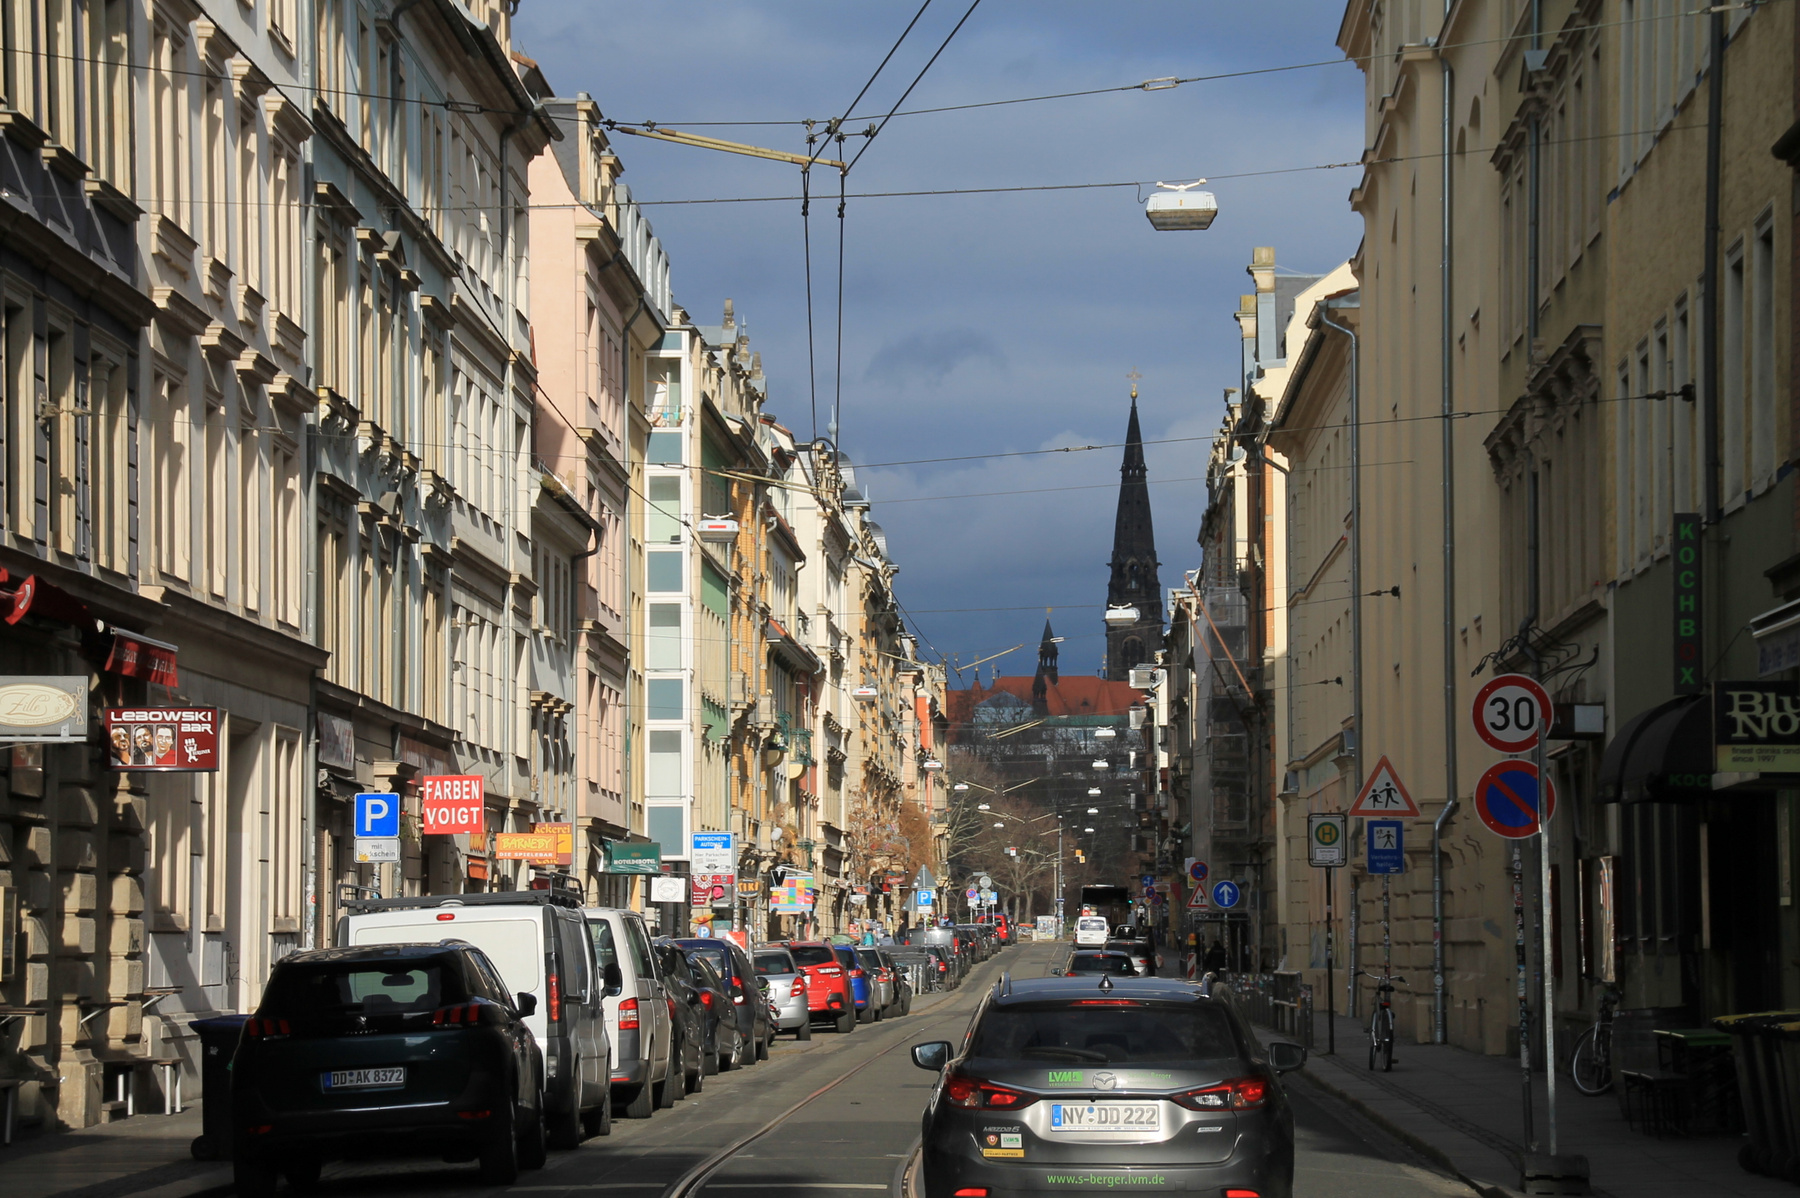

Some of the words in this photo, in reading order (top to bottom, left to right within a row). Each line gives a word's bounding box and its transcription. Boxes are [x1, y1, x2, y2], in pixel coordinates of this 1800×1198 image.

[1679, 522, 1696, 685] KOCHBOX
[111, 711, 212, 722] LEBOWSKI
[1489, 696, 1535, 731] 30
[181, 723, 214, 735] BAR
[1756, 747, 1781, 755] drinks
[1732, 755, 1755, 763] since
[1757, 755, 1776, 763] 1997
[425, 780, 480, 800] FARBEN
[365, 799, 389, 832] P
[426, 807, 481, 825] VOIGT
[1322, 827, 1332, 840] H
[371, 842, 383, 850] mit
[501, 838, 553, 849] BARNEBY
[1371, 853, 1401, 861] Verkehrs-
[738, 882, 760, 893] TIKI
[920, 892, 929, 904] P
[701, 926, 707, 936] P
[332, 1072, 347, 1086] DD
[355, 1070, 371, 1085] AK
[373, 1069, 403, 1083] 8372
[1048, 1071, 1073, 1083] LVM
[1062, 1107, 1085, 1125] NY
[1097, 1107, 1121, 1125] DD
[1124, 1107, 1157, 1125] 222
[1047, 1173, 1166, 1187] www.s-berger.lvm.de
